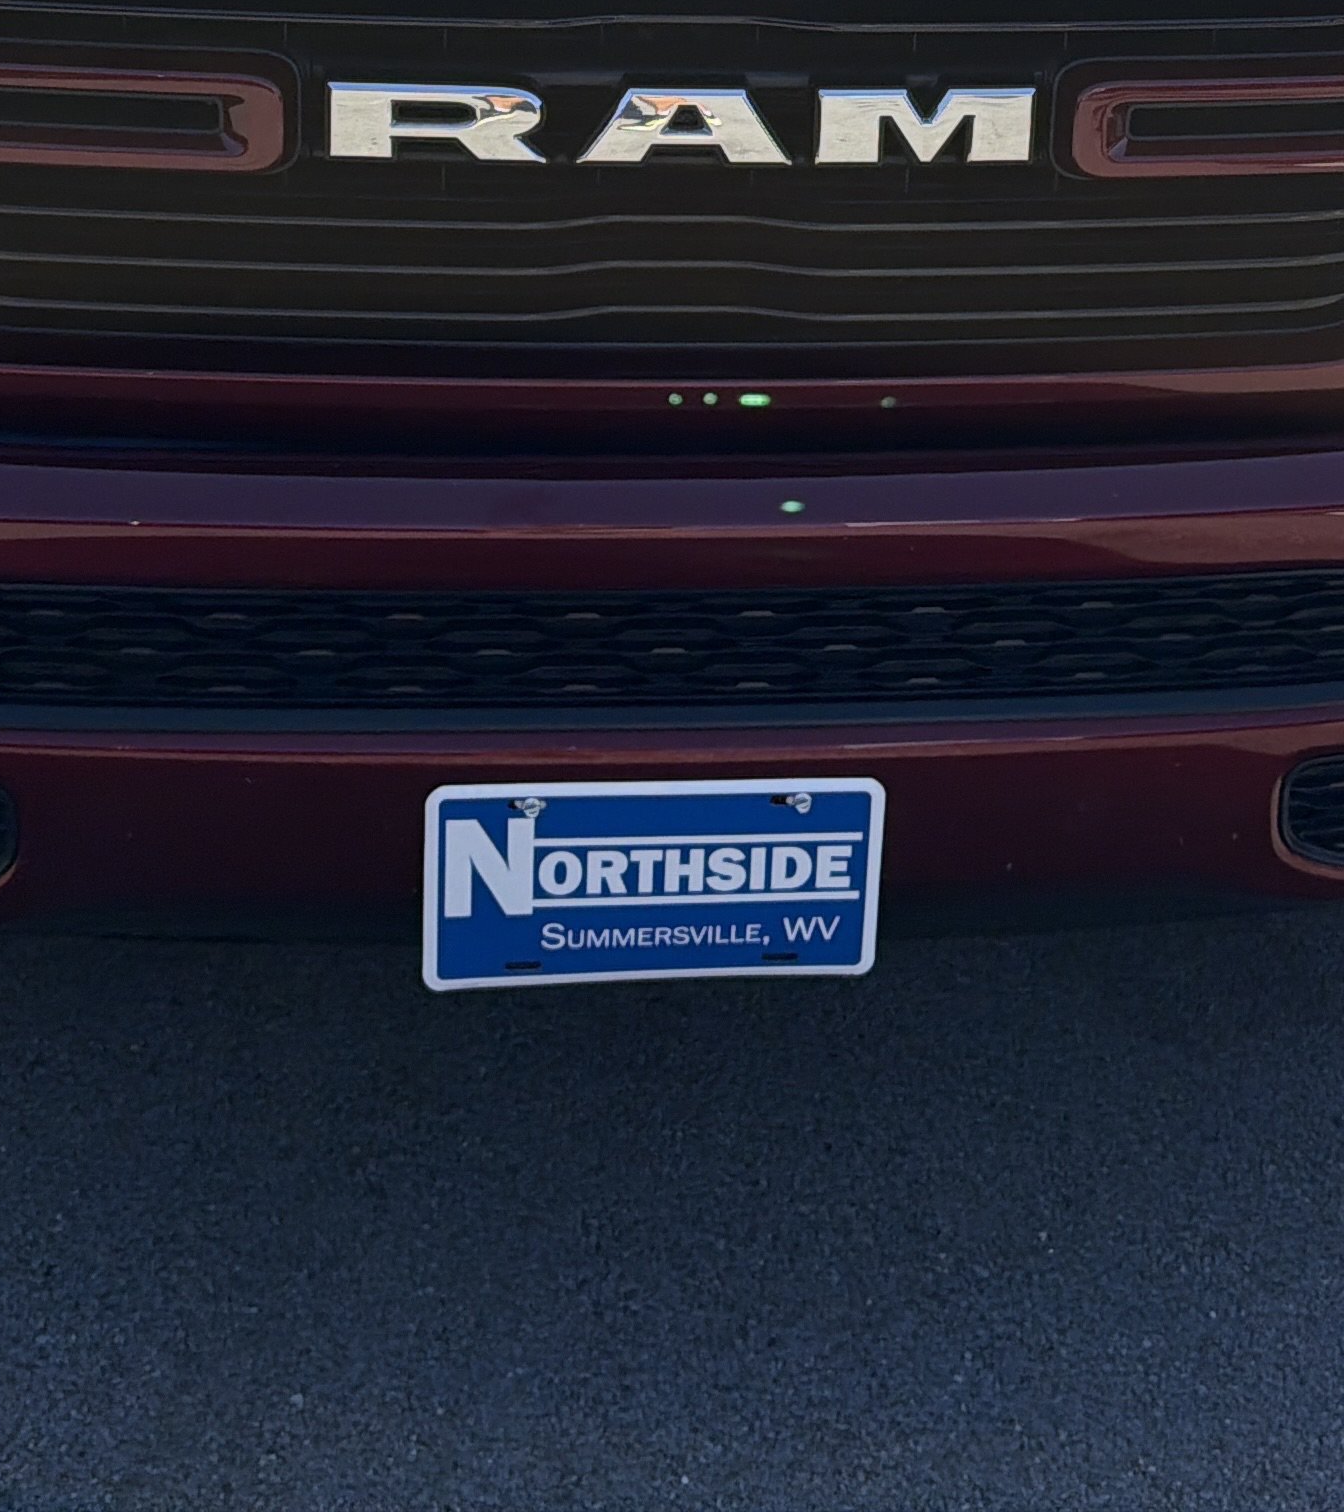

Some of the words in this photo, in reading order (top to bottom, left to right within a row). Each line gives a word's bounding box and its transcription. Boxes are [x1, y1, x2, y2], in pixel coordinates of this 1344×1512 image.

[326, 81, 1036, 164] RAM
[444, 817, 854, 918] NORTHSIDE
[783, 914, 841, 942] WV
